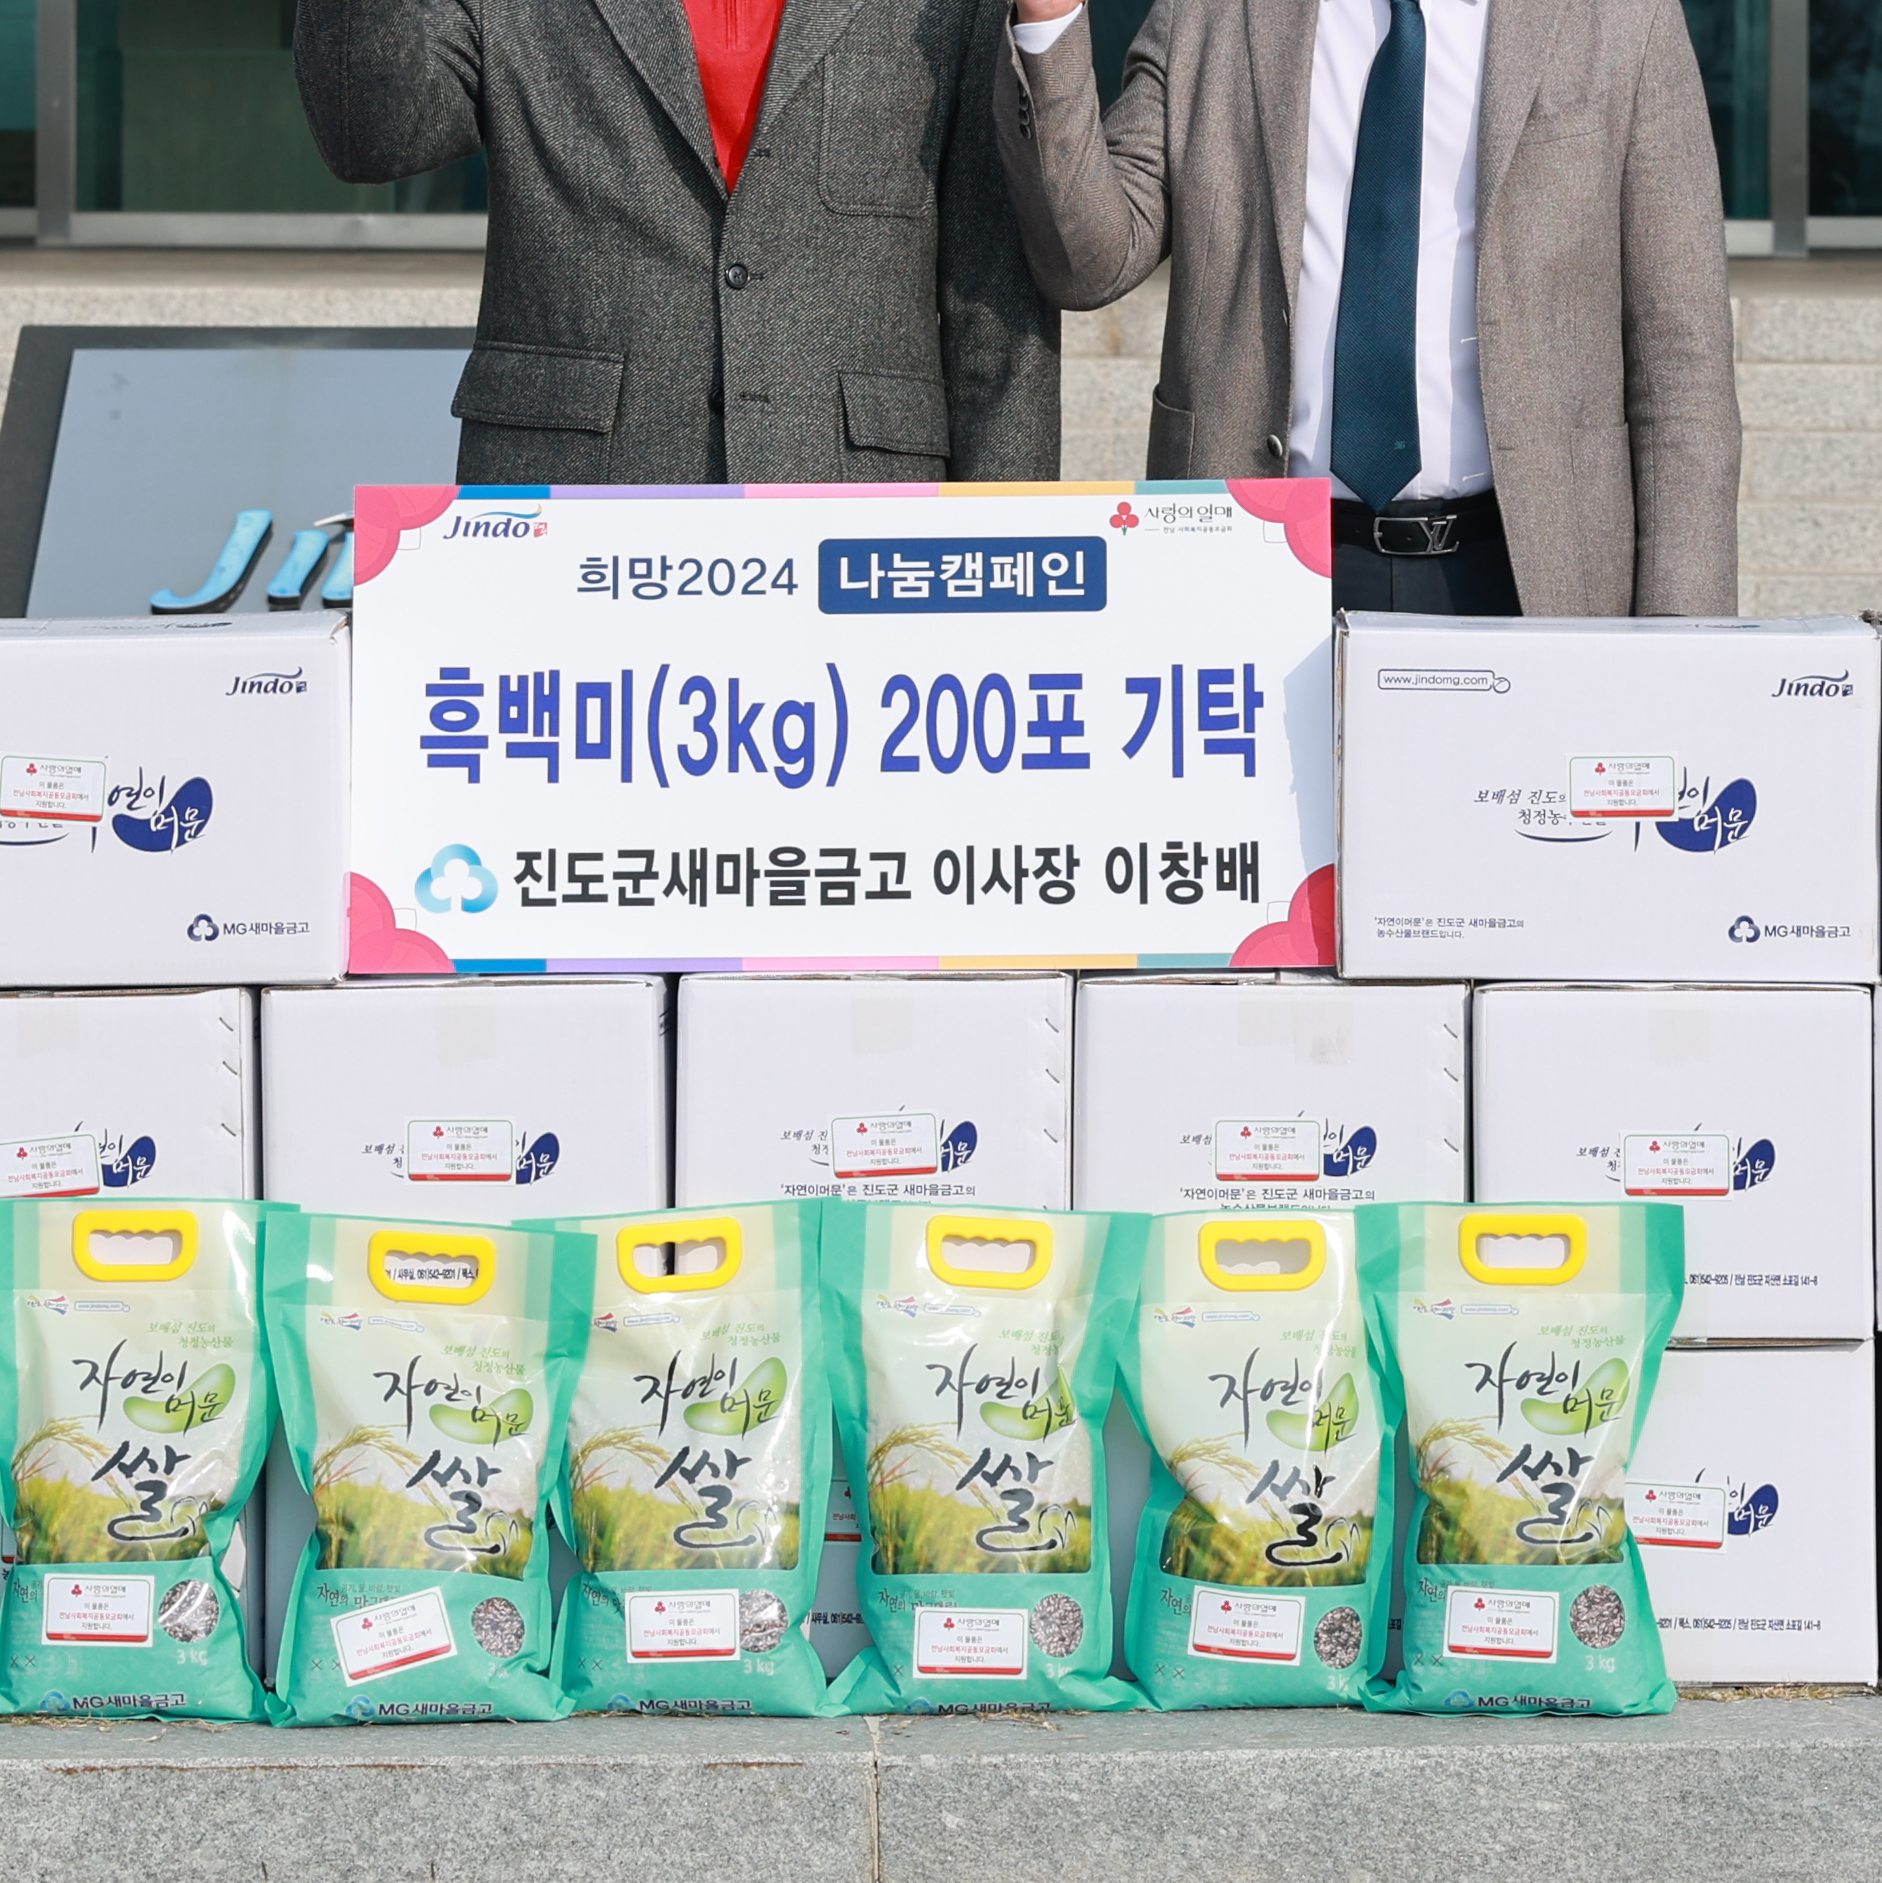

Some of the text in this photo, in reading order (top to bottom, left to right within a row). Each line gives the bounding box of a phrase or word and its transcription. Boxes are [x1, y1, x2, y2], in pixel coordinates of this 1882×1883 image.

[577, 555, 798, 600] 희망2024
[840, 551, 1084, 598] 나눔캠페인
[225, 672, 298, 696] Jindo
[1383, 675, 1488, 687] www.jindomg.com
[1771, 678, 1840, 698] Jindo
[420, 663, 1264, 789] 흑백미(3kg) 200포 기탁
[1473, 788, 1523, 805] 보배섬
[514, 841, 1259, 907] 진도군새마을금고 이사장 이창배
[1376, 928, 1462, 939] 농수산물브랜드입니다.
[1436, 917, 1466, 928] 진도군
[1468, 917, 1524, 929] 새마을금고의
[862, 1183, 899, 1197] 진도군
[903, 1183, 976, 1197] 새마을금고의
[1261, 1187, 1298, 1201] 진도군
[1302, 1188, 1375, 1201] 새마을금고의
[91, 1440, 191, 1542] 쌀
[407, 1450, 503, 1554] 쌀
[655, 1446, 753, 1550] 쌀
[956, 1447, 1057, 1553] 쌀
[1246, 1459, 1341, 1567] 쌀
[1497, 1444, 1594, 1546] 쌀
